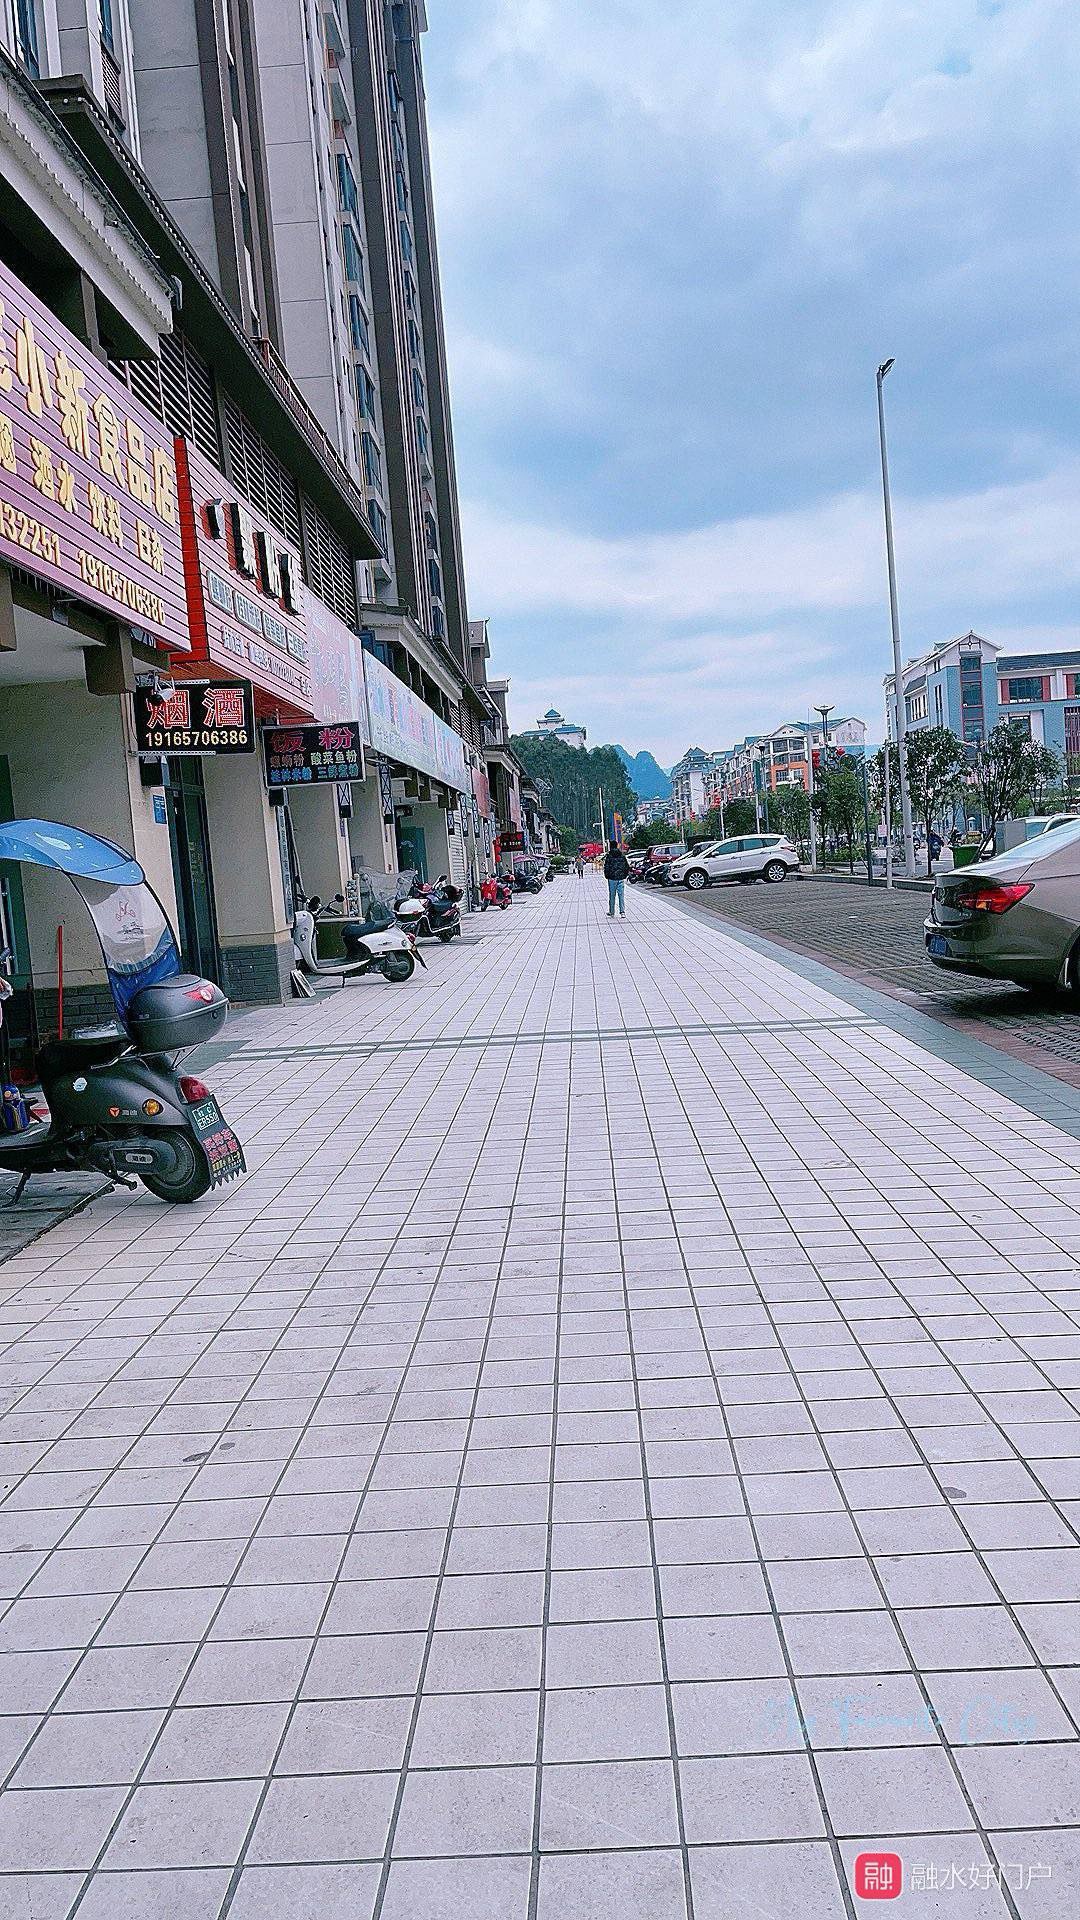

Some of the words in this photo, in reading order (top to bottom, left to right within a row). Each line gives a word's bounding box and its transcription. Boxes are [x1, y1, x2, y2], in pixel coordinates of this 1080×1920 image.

[30, 436, 78, 514] 酒水
[88, 480, 124, 549] 饮料
[77, 549, 166, 626] 19165706386
[145, 729, 248, 747] 19165706386
[310, 749, 358, 766] 酸菜鱼粉
